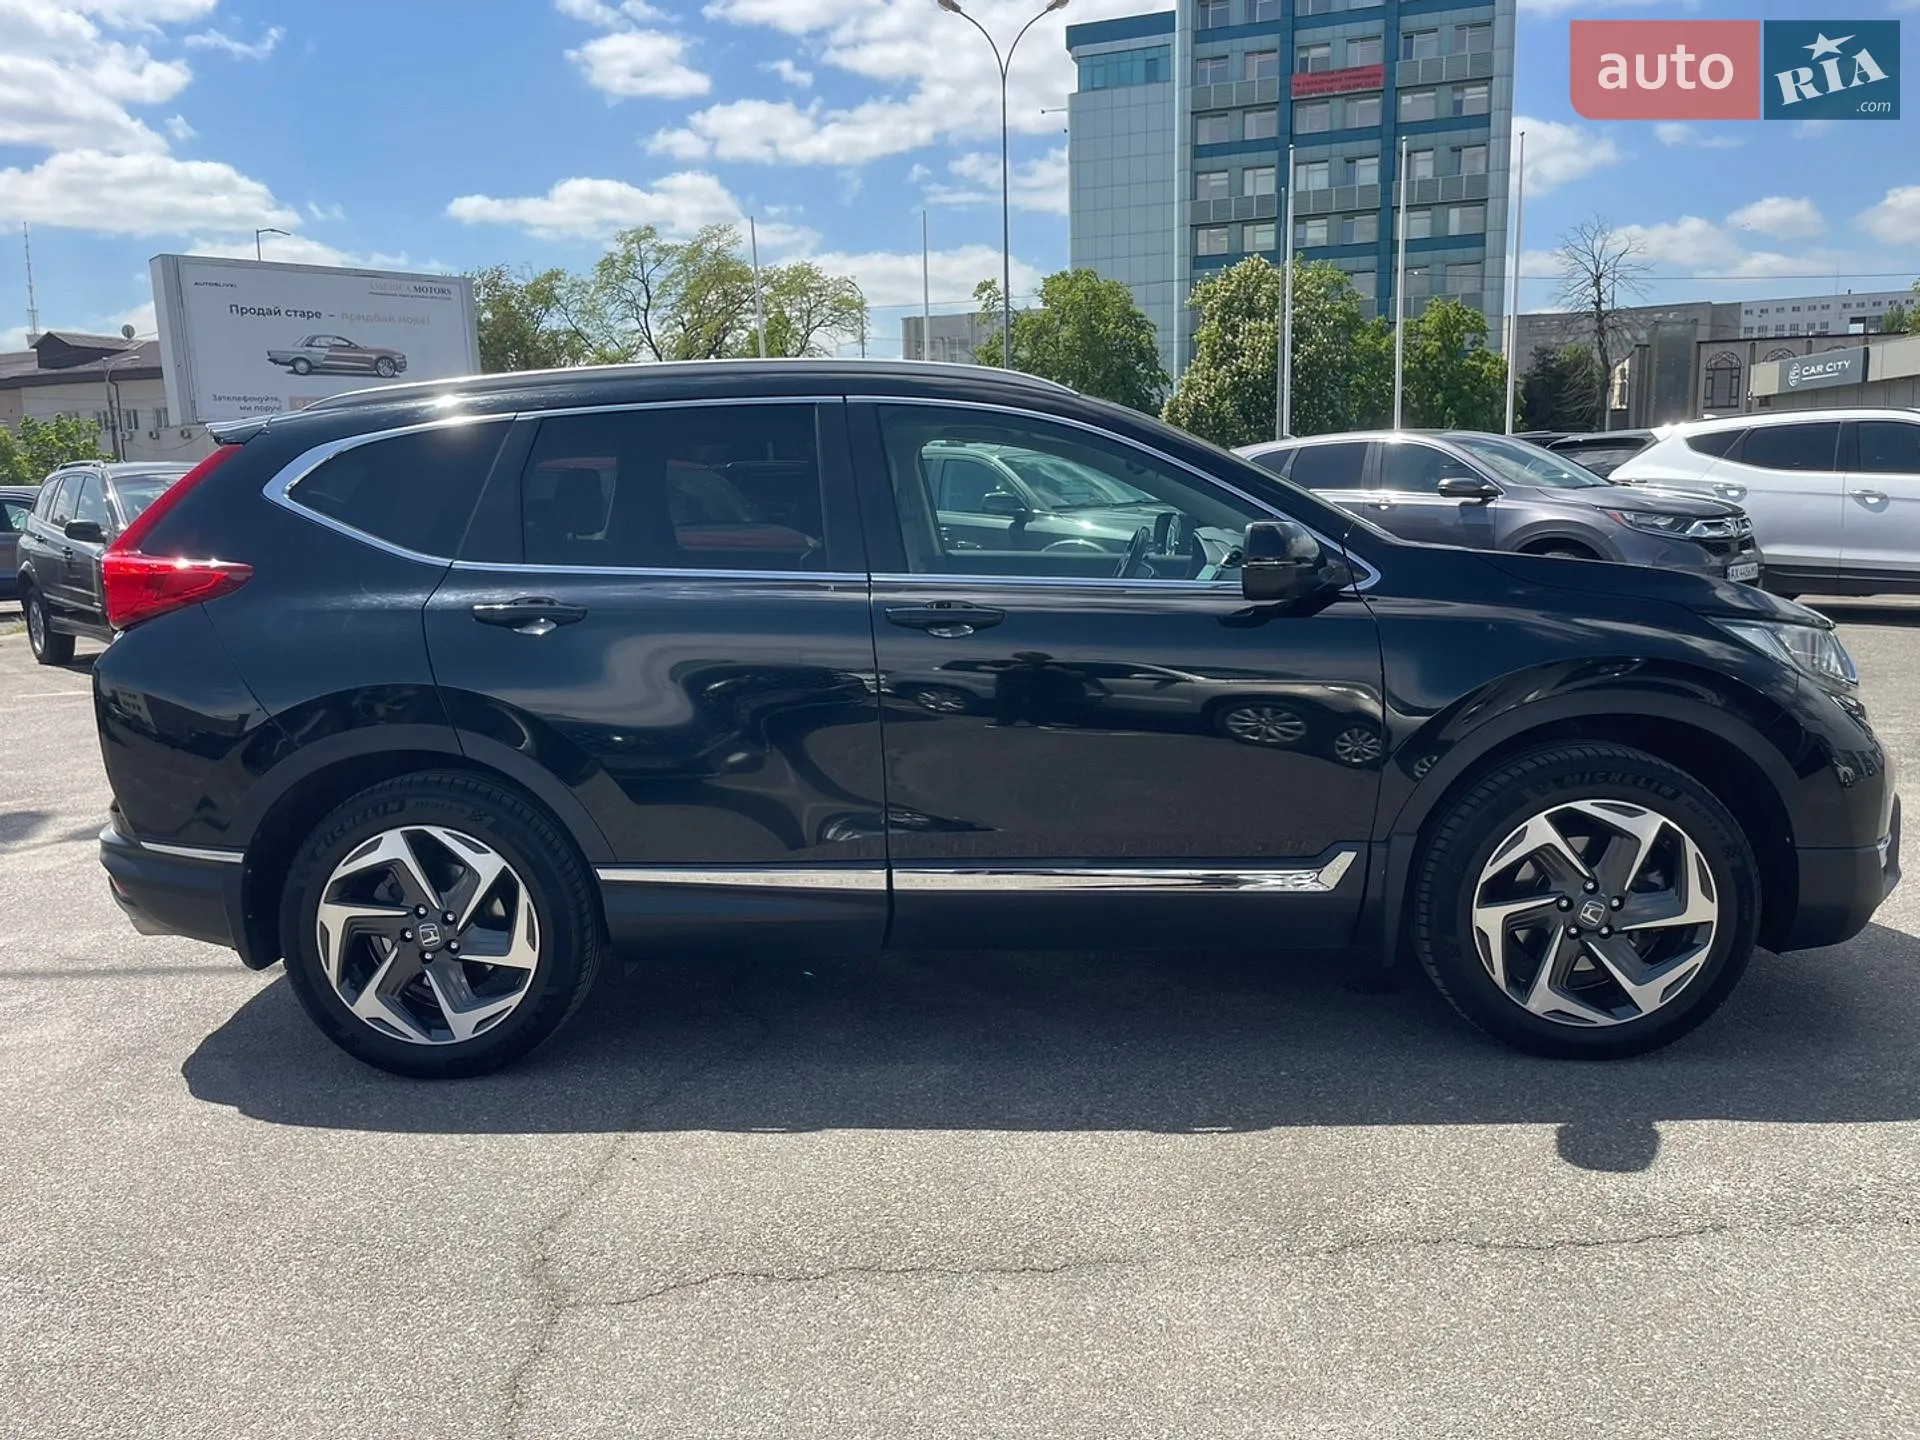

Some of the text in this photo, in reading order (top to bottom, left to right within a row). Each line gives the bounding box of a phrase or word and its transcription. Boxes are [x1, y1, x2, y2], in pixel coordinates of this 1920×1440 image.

[413, 286, 453, 296] MOTORS
[229, 303, 282, 318] Продай
[285, 309, 323, 321] старе
[1802, 360, 1851, 376] CAR CITY
[1563, 771, 1677, 799] MICHELIN
[314, 802, 401, 858] MICHELIN
